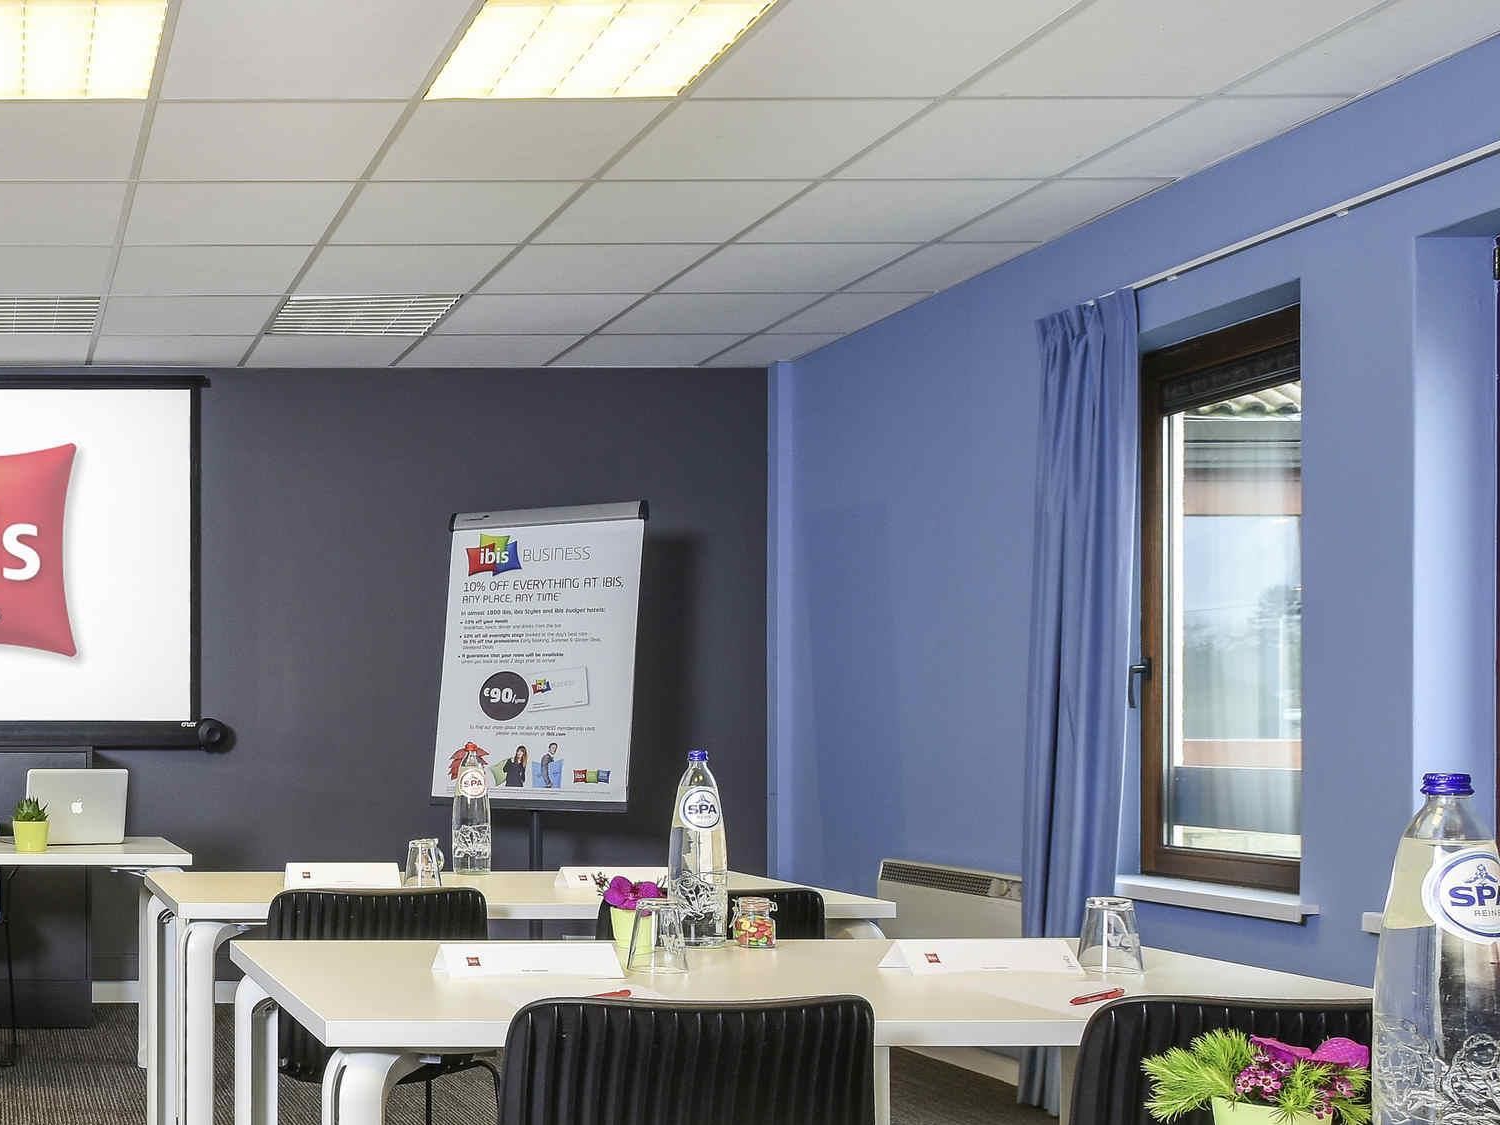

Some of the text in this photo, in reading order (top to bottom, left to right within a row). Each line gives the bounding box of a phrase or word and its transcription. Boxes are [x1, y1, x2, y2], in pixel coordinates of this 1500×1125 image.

[479, 545, 592, 565] ibis BUSINESS
[463, 581, 486, 593] 10%
[489, 580, 509, 592] OFF
[513, 578, 580, 591] EVERYTHING
[583, 577, 598, 589] AT
[462, 595, 481, 604] ANY
[515, 592, 534, 603] ANY
[687, 804, 717, 815] SPA
[1448, 885, 1500, 907] SP
